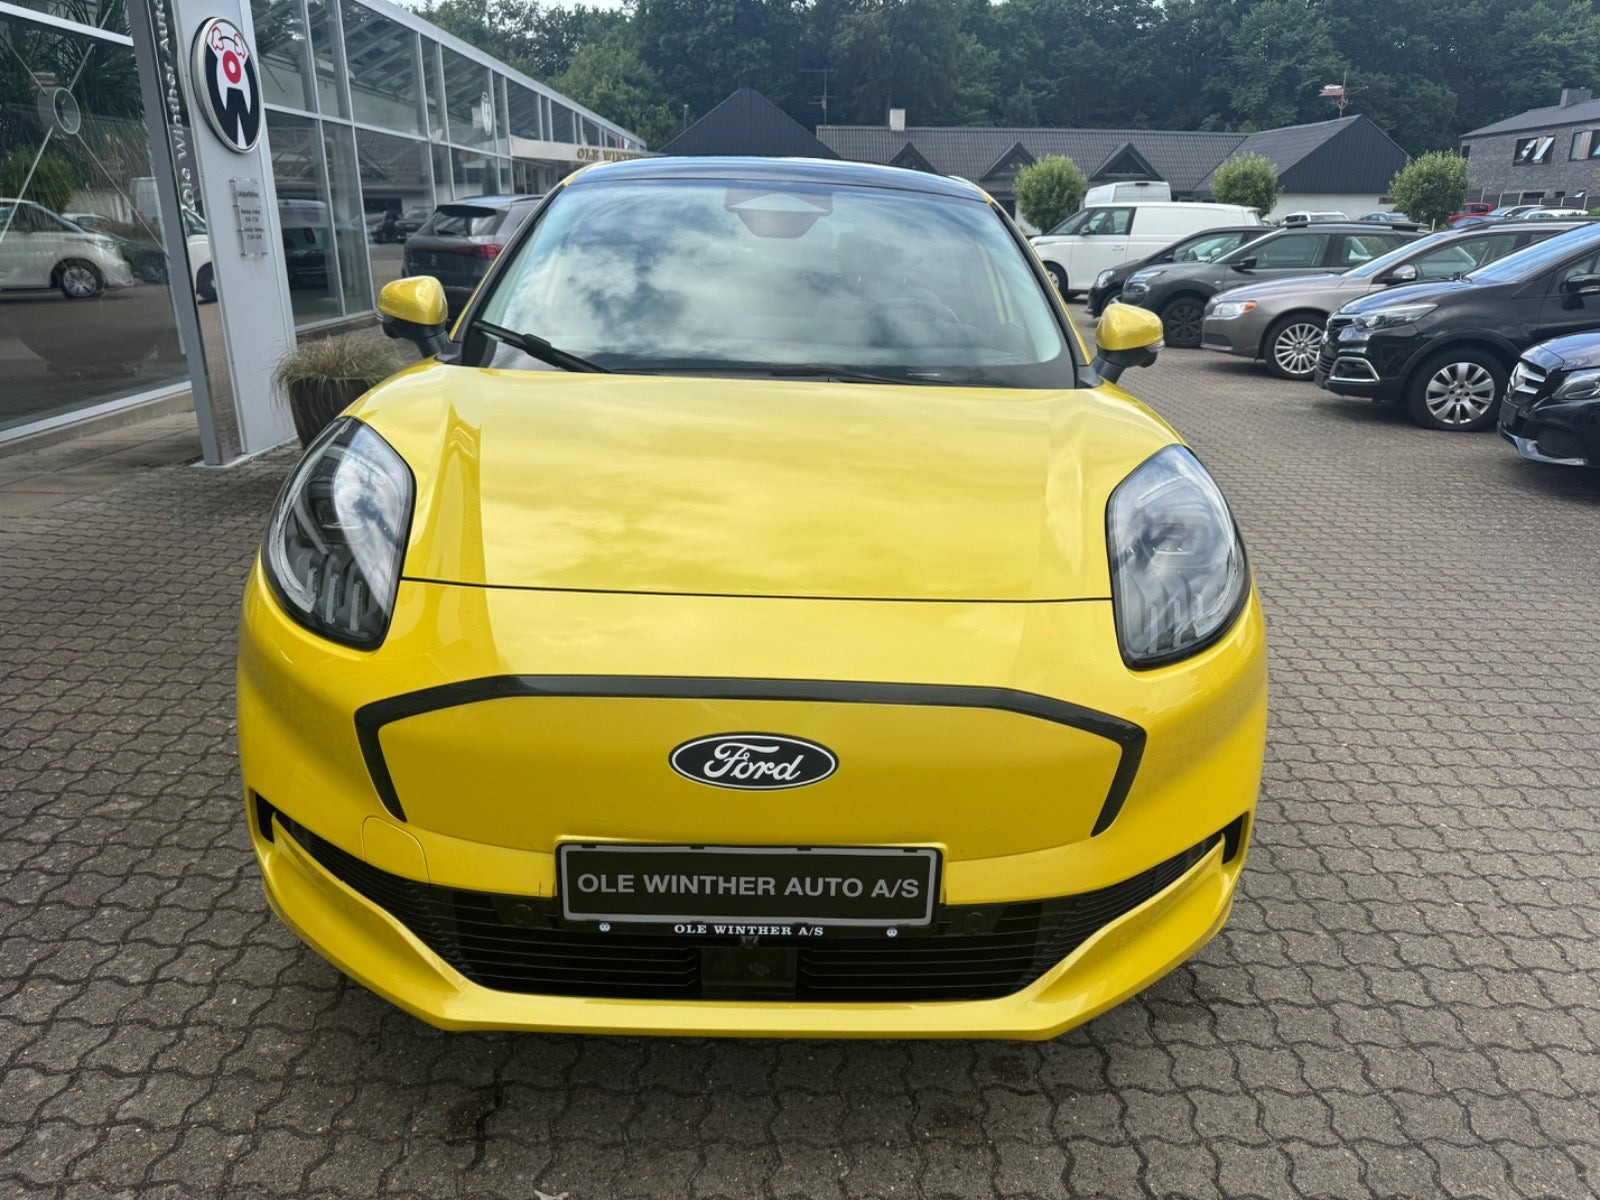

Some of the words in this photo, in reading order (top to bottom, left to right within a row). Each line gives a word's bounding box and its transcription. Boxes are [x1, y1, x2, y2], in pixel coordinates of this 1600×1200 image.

[164, 61, 188, 160] Winther
[576, 147, 599, 161] OLE
[181, 167, 195, 205] Ole
[703, 742, 805, 781] Ford
[577, 873, 635, 893] OLE
[643, 874, 776, 896] WINTHER
[783, 877, 864, 898] AUTO
[871, 878, 920, 898] A/S
[673, 924, 707, 934] OLE
[713, 924, 793, 936] WINTHER
[798, 926, 824, 936] A/S
